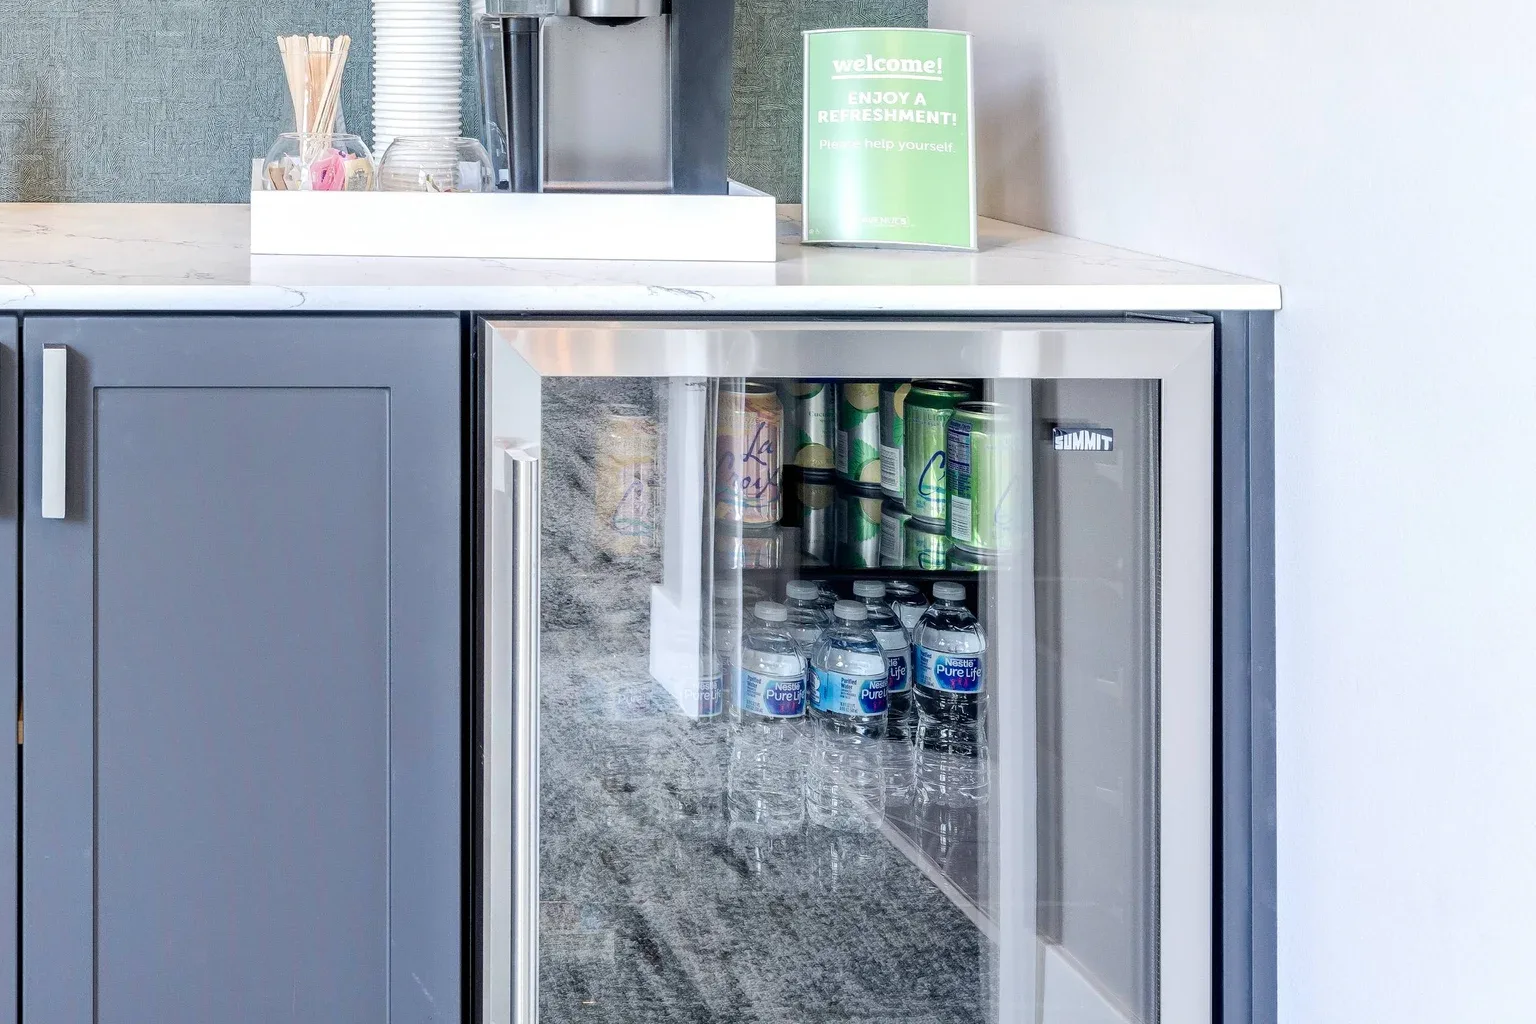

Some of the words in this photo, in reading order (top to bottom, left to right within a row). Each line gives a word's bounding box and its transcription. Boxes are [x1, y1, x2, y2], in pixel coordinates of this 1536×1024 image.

[832, 53, 942, 74] welcome!
[847, 91, 911, 106] ENJOY
[913, 91, 927, 106] A
[817, 108, 957, 126] REFRESHMENT!
[864, 138, 895, 151] help
[898, 140, 956, 153] yourself.
[742, 421, 774, 466] La
[1054, 429, 1113, 451] SUMMIT
[890, 666, 906, 680] Life
[936, 664, 964, 677] Pure
[965, 665, 982, 681] Life
[766, 689, 792, 702] Pure
[793, 689, 805, 705] Life
[861, 689, 883, 700] Pure
